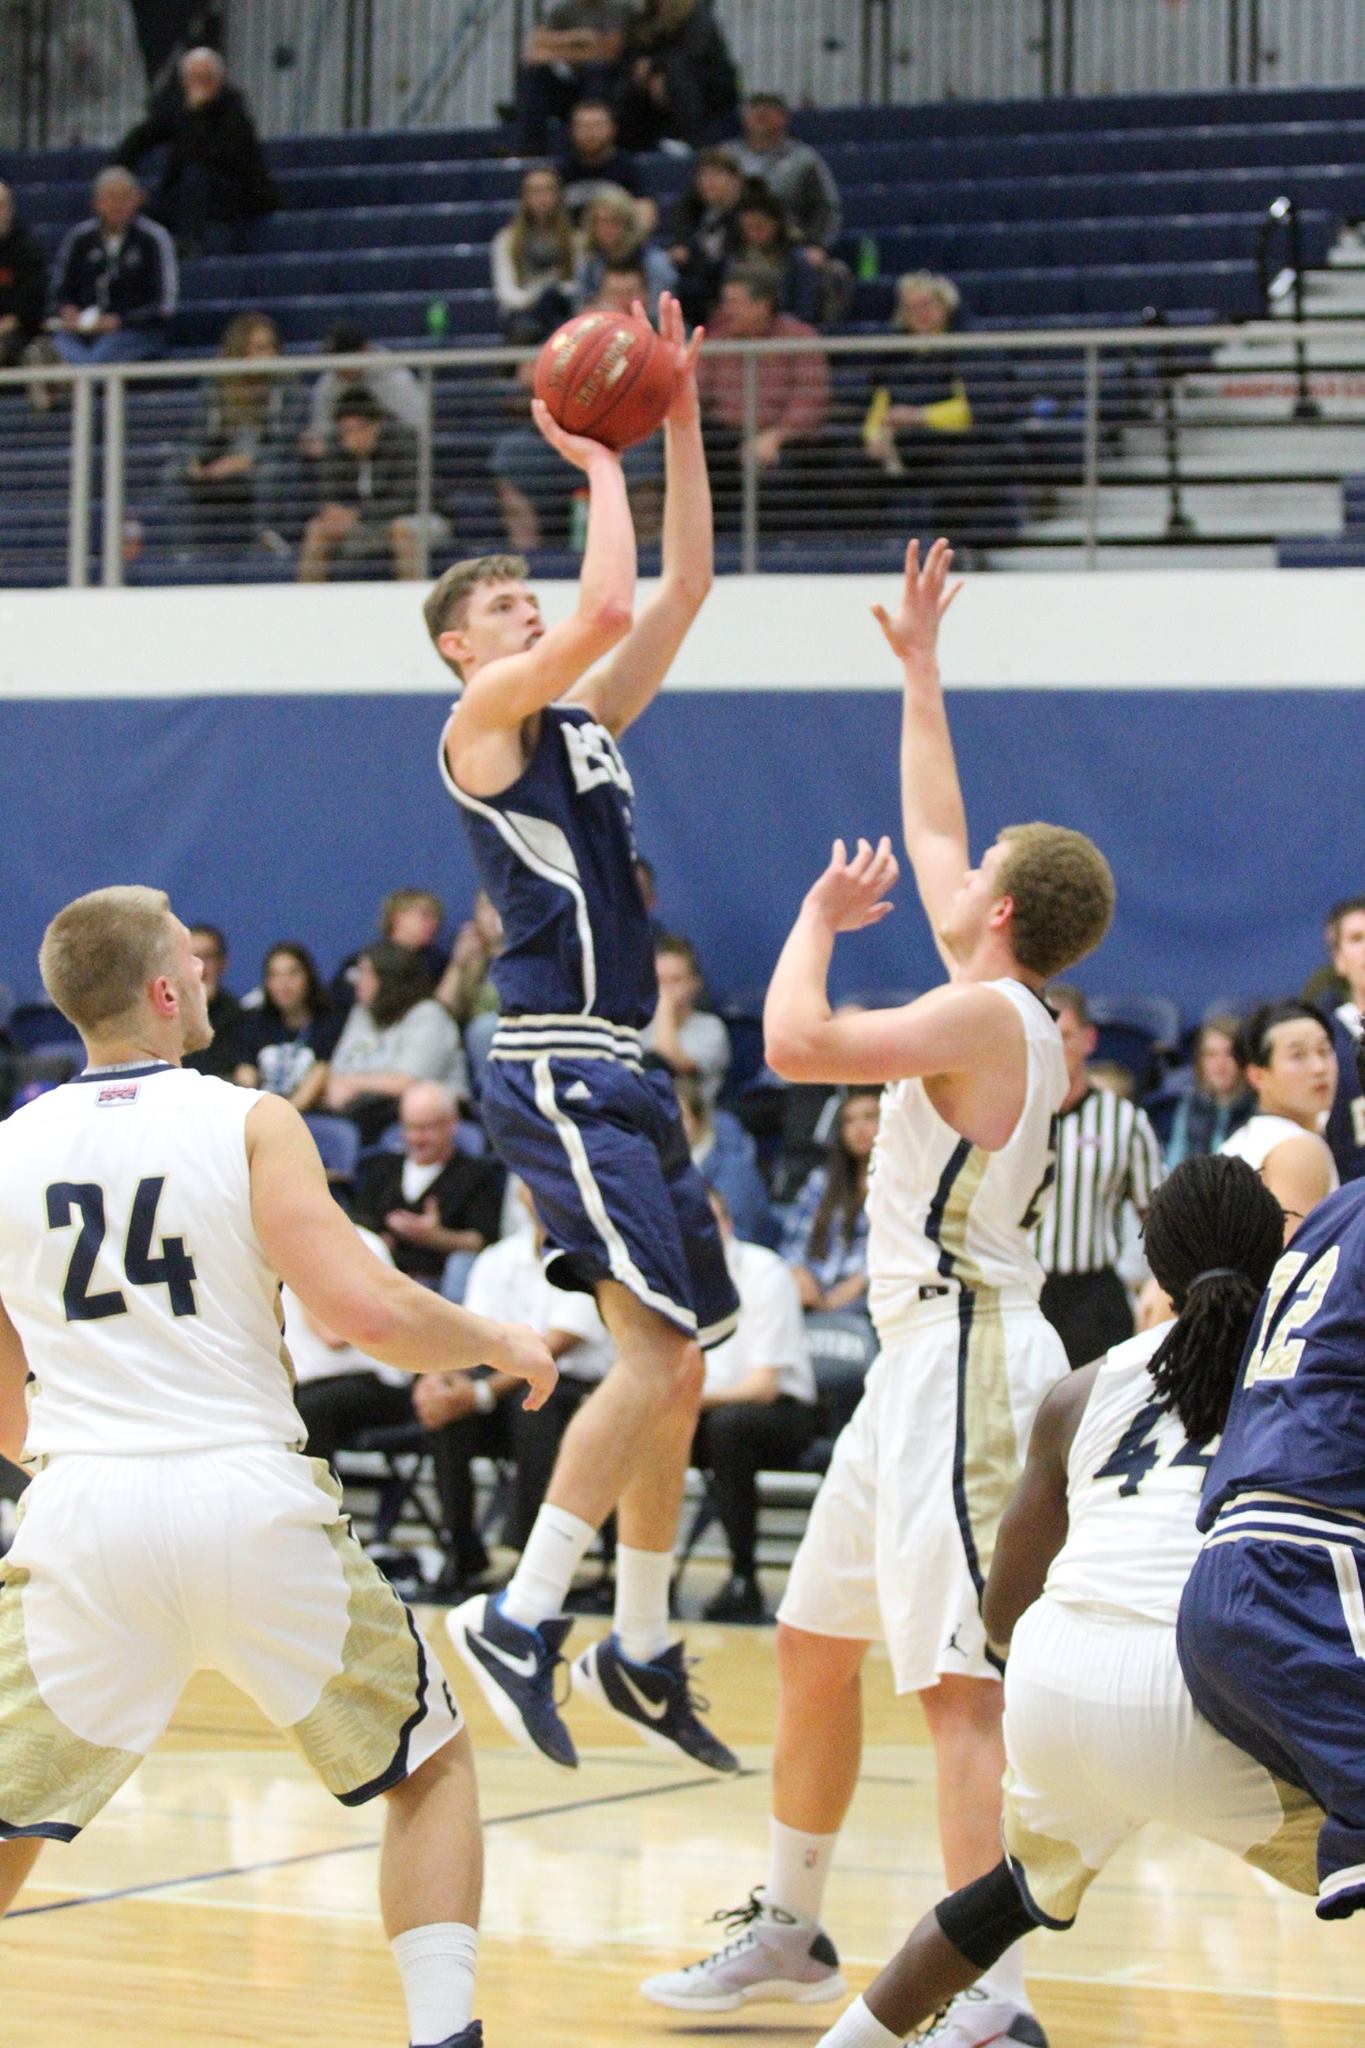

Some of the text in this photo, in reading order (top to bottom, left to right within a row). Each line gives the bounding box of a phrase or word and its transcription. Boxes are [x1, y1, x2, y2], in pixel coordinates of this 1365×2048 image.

[44, 1174, 199, 1323] 24
[1243, 1245, 1340, 1390] 12
[1092, 1402, 1217, 1498] 4
